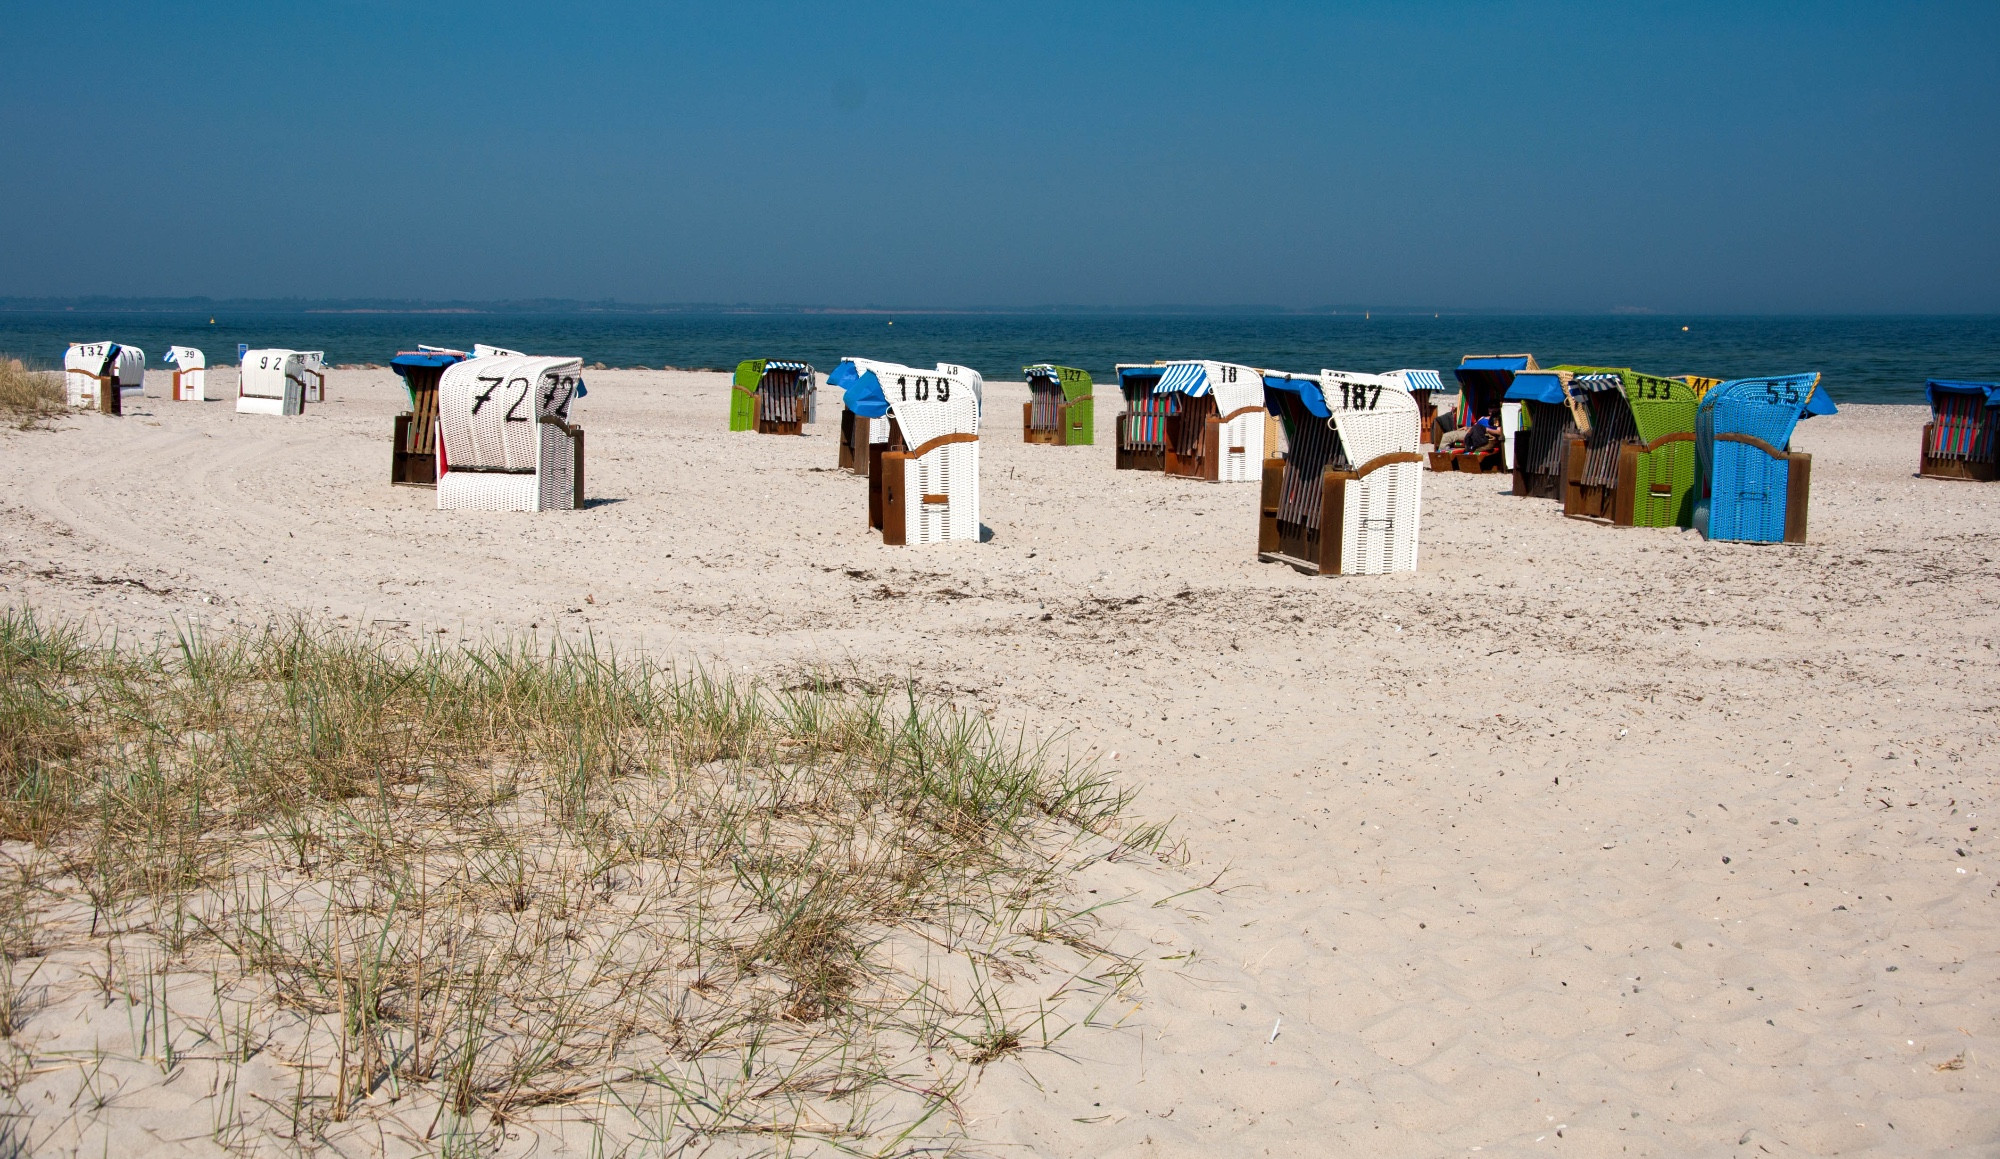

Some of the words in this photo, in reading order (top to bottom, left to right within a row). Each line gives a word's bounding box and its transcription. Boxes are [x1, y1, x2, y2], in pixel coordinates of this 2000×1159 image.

[80, 345, 104, 357] 132
[184, 350, 195, 359] 39
[260, 356, 282, 370] 92
[752, 361, 762, 373] 89
[946, 366, 958, 376] 48
[1064, 369, 1081, 382] 127
[1221, 365, 1237, 383] 18
[543, 373, 574, 418] 72
[897, 376, 950, 402] 109
[1340, 382, 1382, 410] 187
[1636, 376, 1671, 400] 133
[1766, 381, 1798, 405] 55
[472, 377, 528, 422] 72
